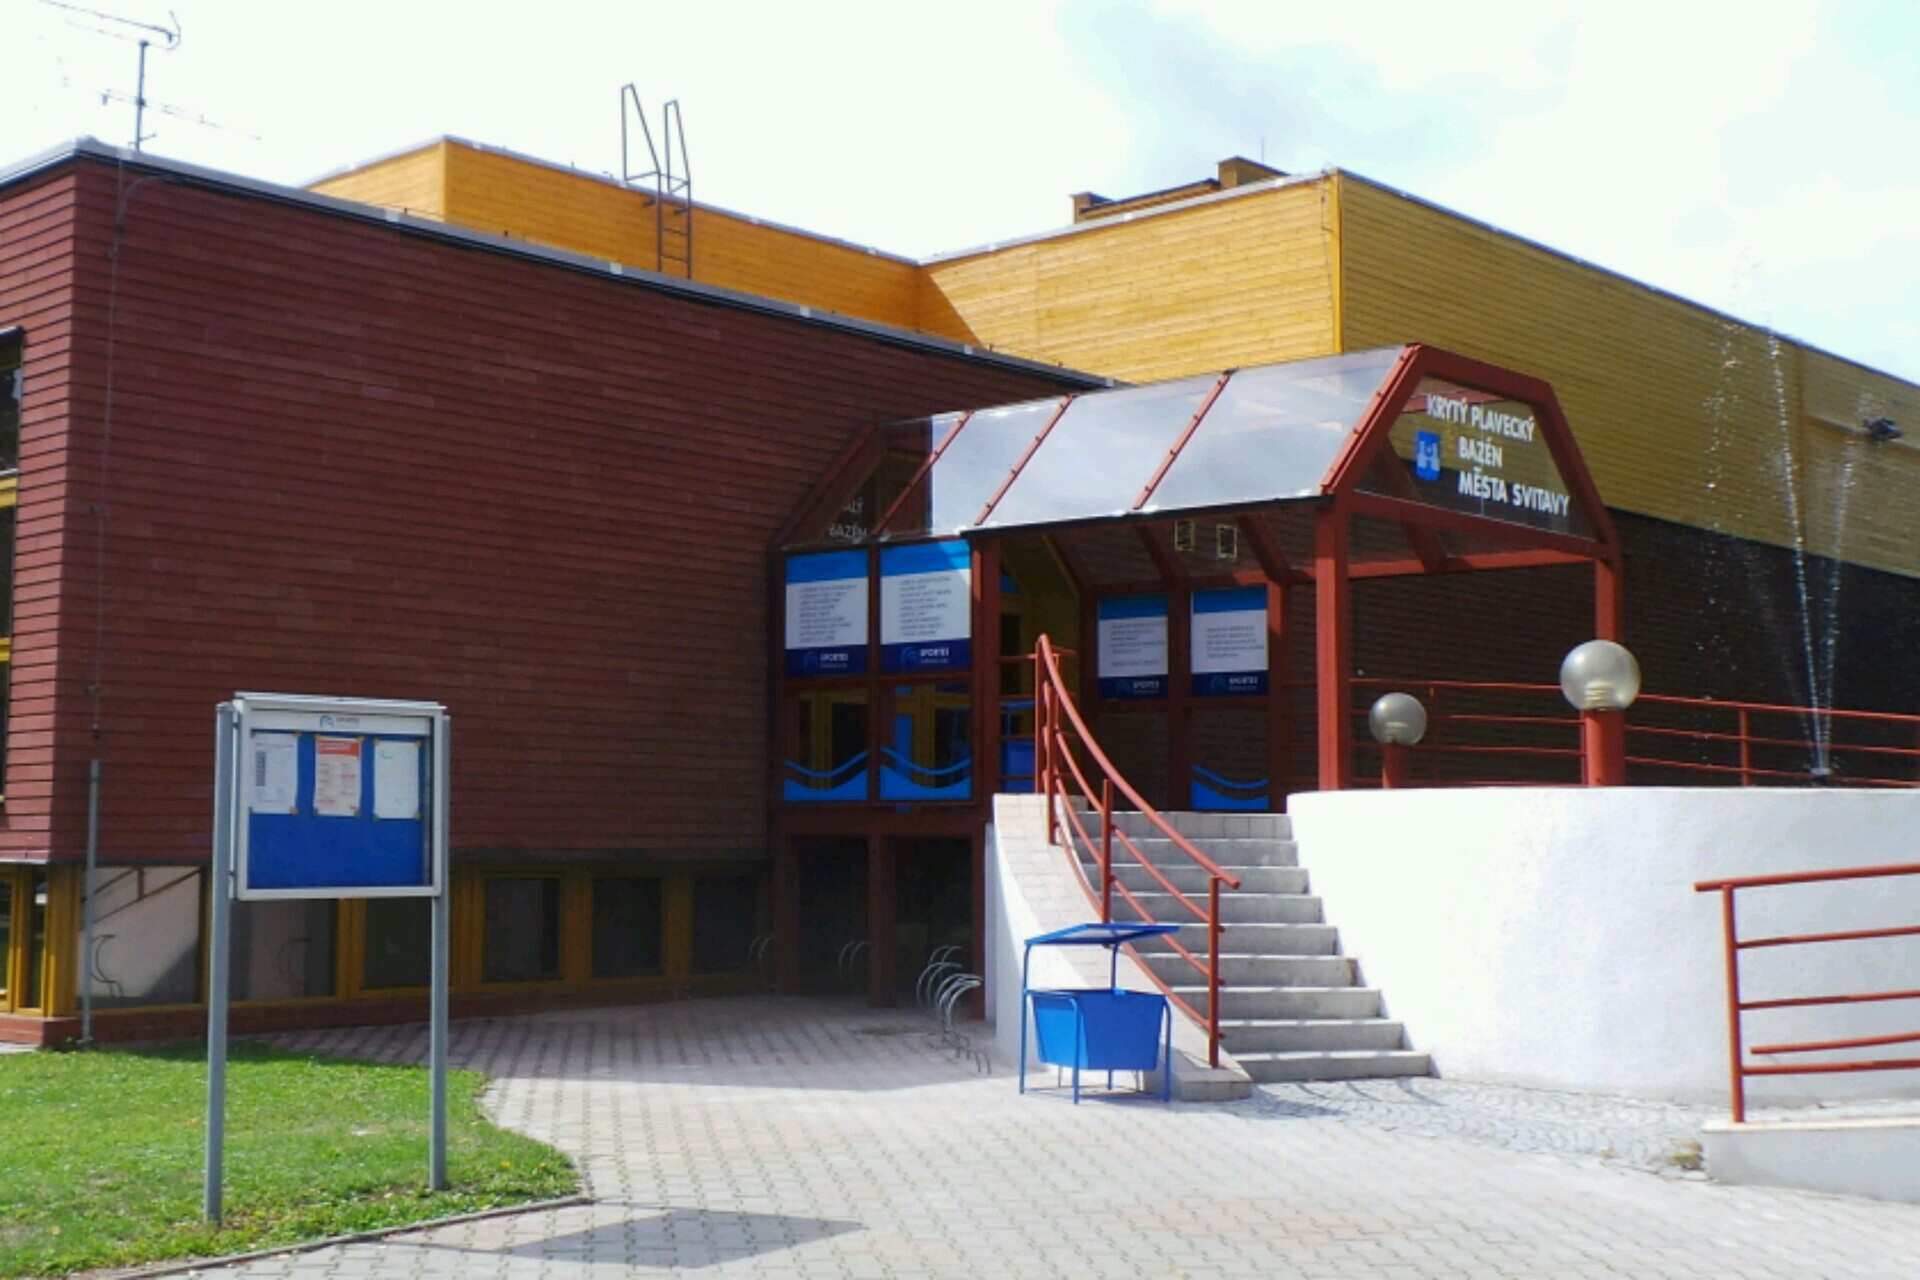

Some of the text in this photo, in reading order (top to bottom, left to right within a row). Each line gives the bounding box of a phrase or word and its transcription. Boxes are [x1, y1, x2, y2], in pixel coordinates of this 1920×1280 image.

[1427, 394, 1536, 441] KRYTÝ PLAVECKÝ
[1458, 436, 1503, 467] BAZÉN
[1458, 466, 1570, 517] MĚSTA SVITAVY
